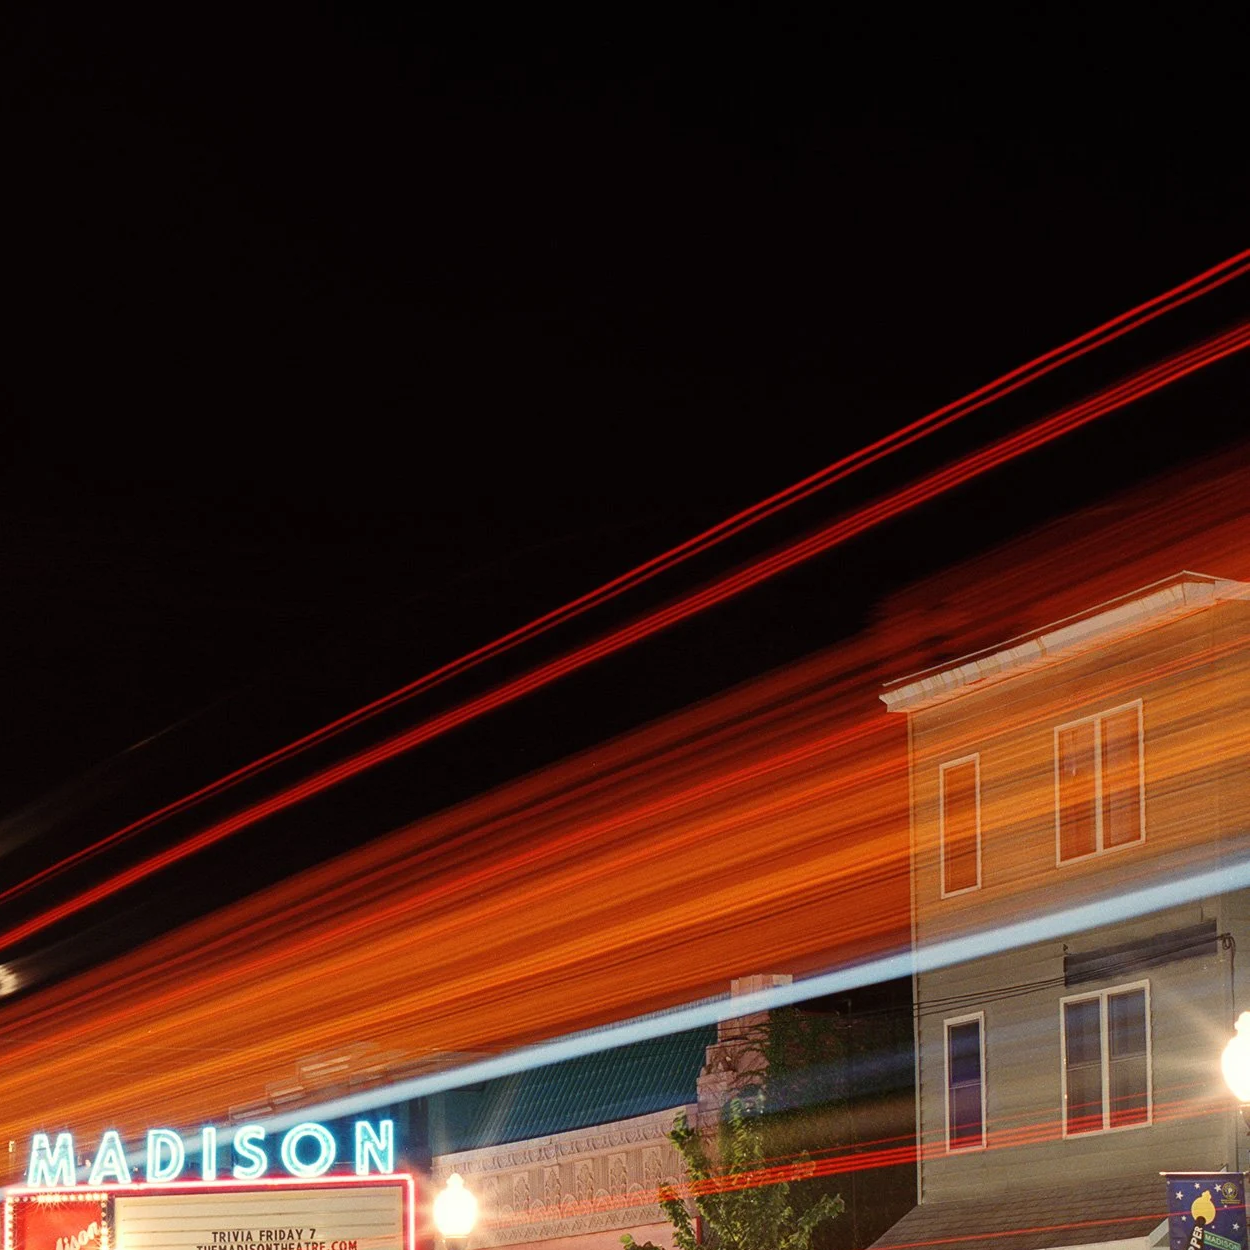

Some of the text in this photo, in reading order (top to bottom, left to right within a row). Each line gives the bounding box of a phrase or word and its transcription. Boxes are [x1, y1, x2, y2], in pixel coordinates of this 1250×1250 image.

[26, 1118, 394, 1188] MADISON
[212, 1228, 317, 1243] TRIVIA FRIDAY 7
